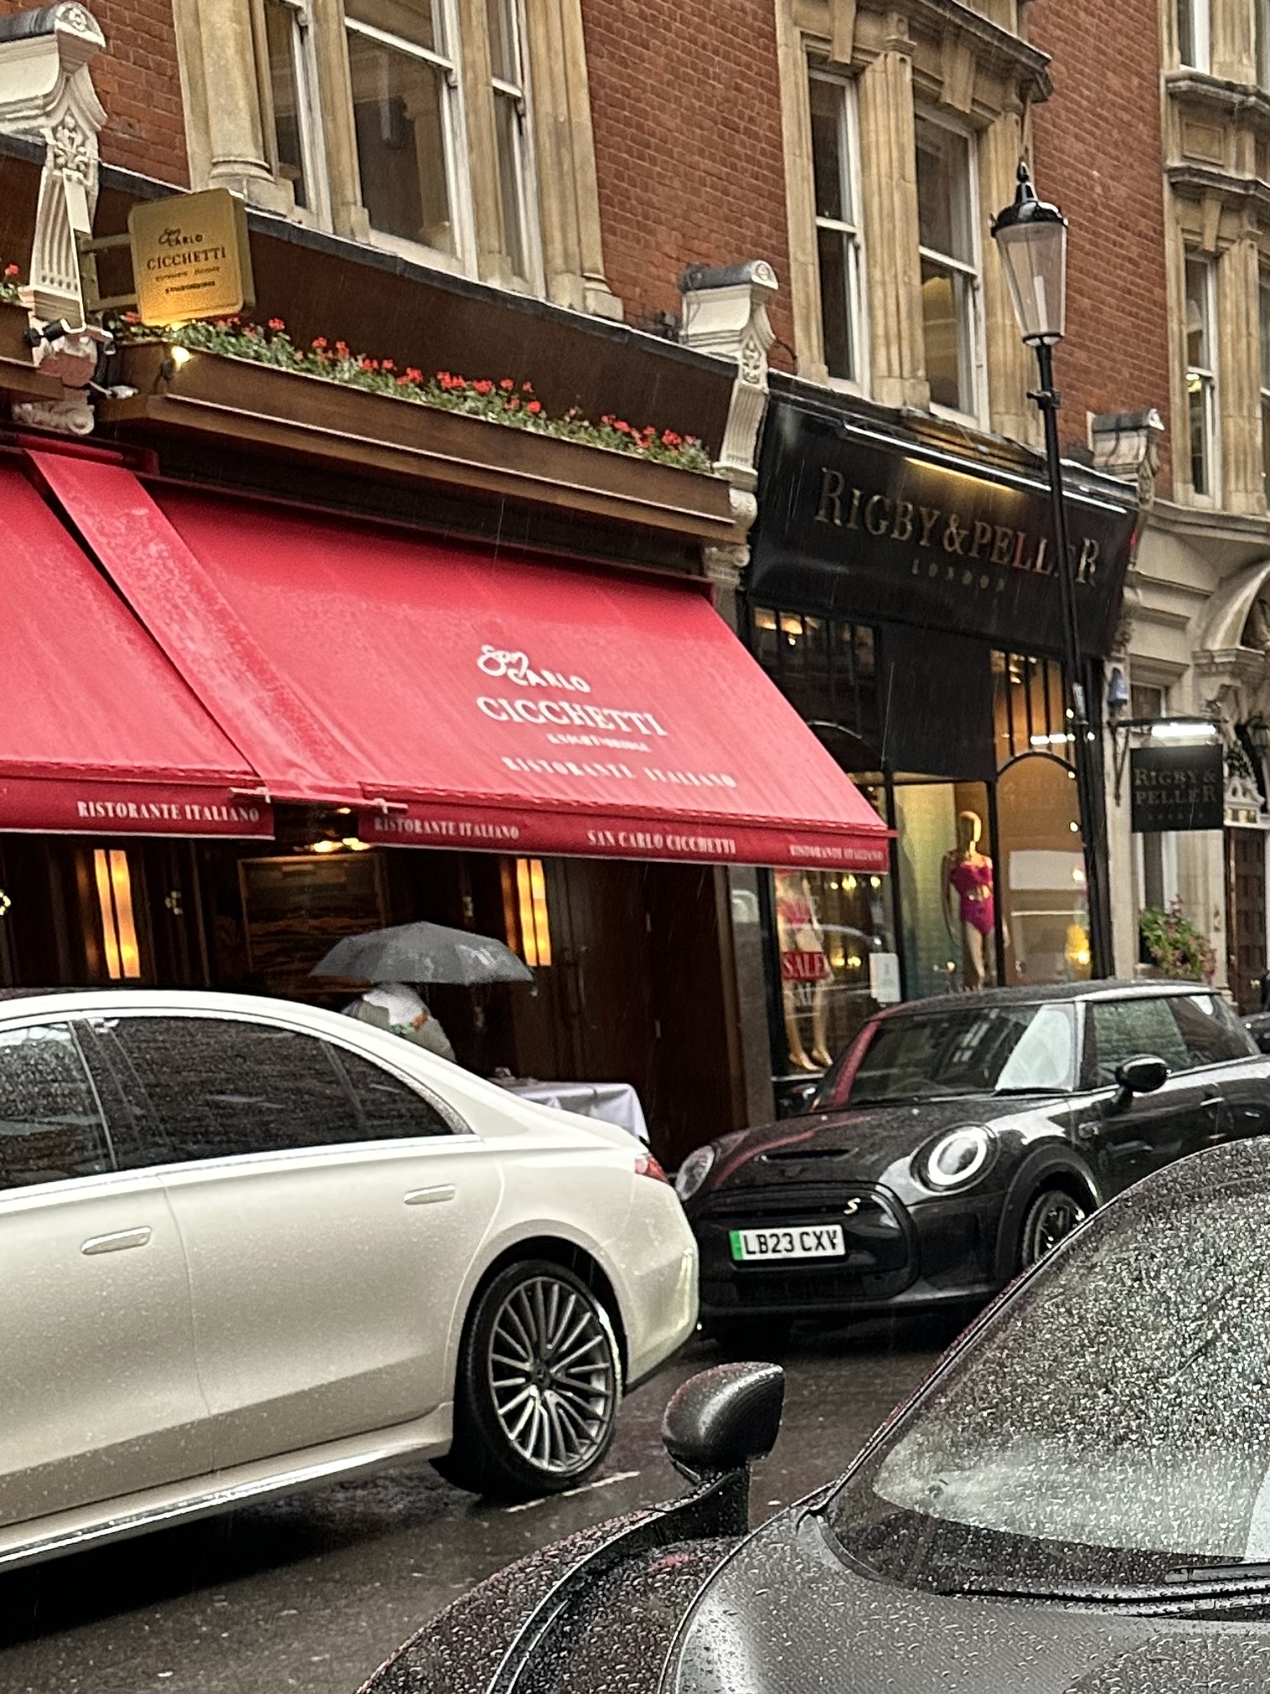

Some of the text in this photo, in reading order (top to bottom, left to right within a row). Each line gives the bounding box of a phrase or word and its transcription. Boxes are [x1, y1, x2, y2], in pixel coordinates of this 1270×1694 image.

[168, 234, 203, 247] CARLO
[147, 246, 226, 271] CICCHETTI
[507, 668, 591, 693] CARLO
[476, 696, 668, 737] CICCHETTI
[502, 756, 737, 788] RISTORANTE ITALIANO
[77, 801, 260, 823] RISTORANTE ITALIANO
[374, 818, 520, 840] RISTORANTE ITALIANO
[587, 829, 737, 856] SAN CARLO CICCHETTI
[783, 954, 824, 977] SALE
[743, 1228, 838, 1256] LB23 CXV
